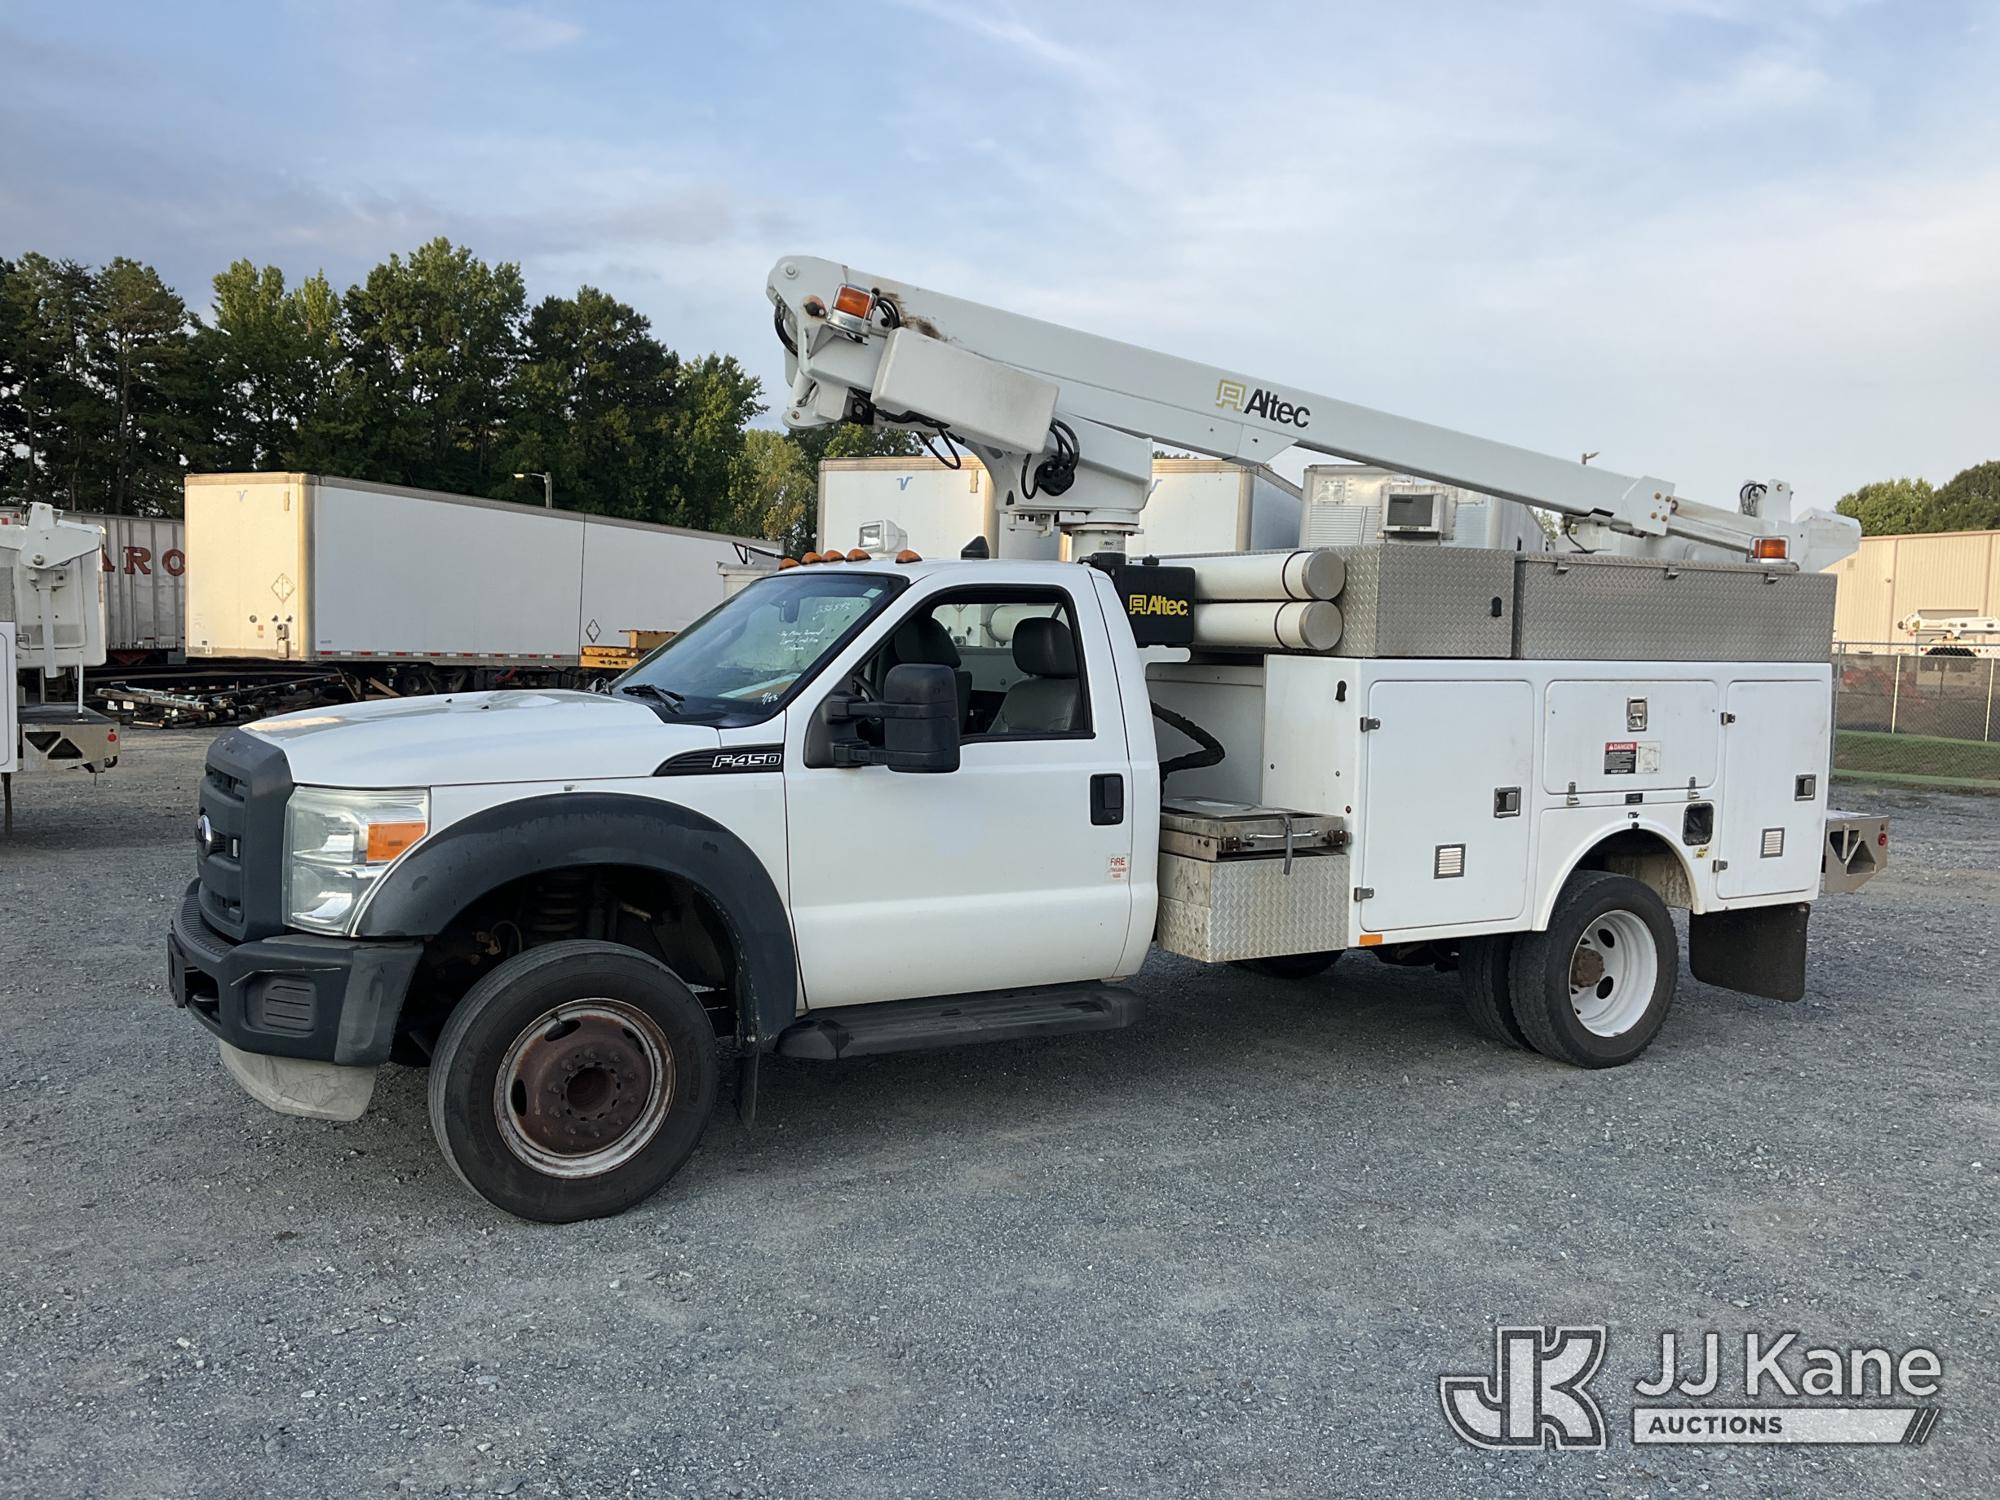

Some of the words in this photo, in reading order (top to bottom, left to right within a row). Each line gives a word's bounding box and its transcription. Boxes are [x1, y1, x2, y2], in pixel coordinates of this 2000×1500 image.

[1243, 388, 1311, 428] Altec
[1146, 595, 1189, 616] Altec
[712, 753, 782, 769] F-450
[1110, 857, 1126, 866] FIRE
